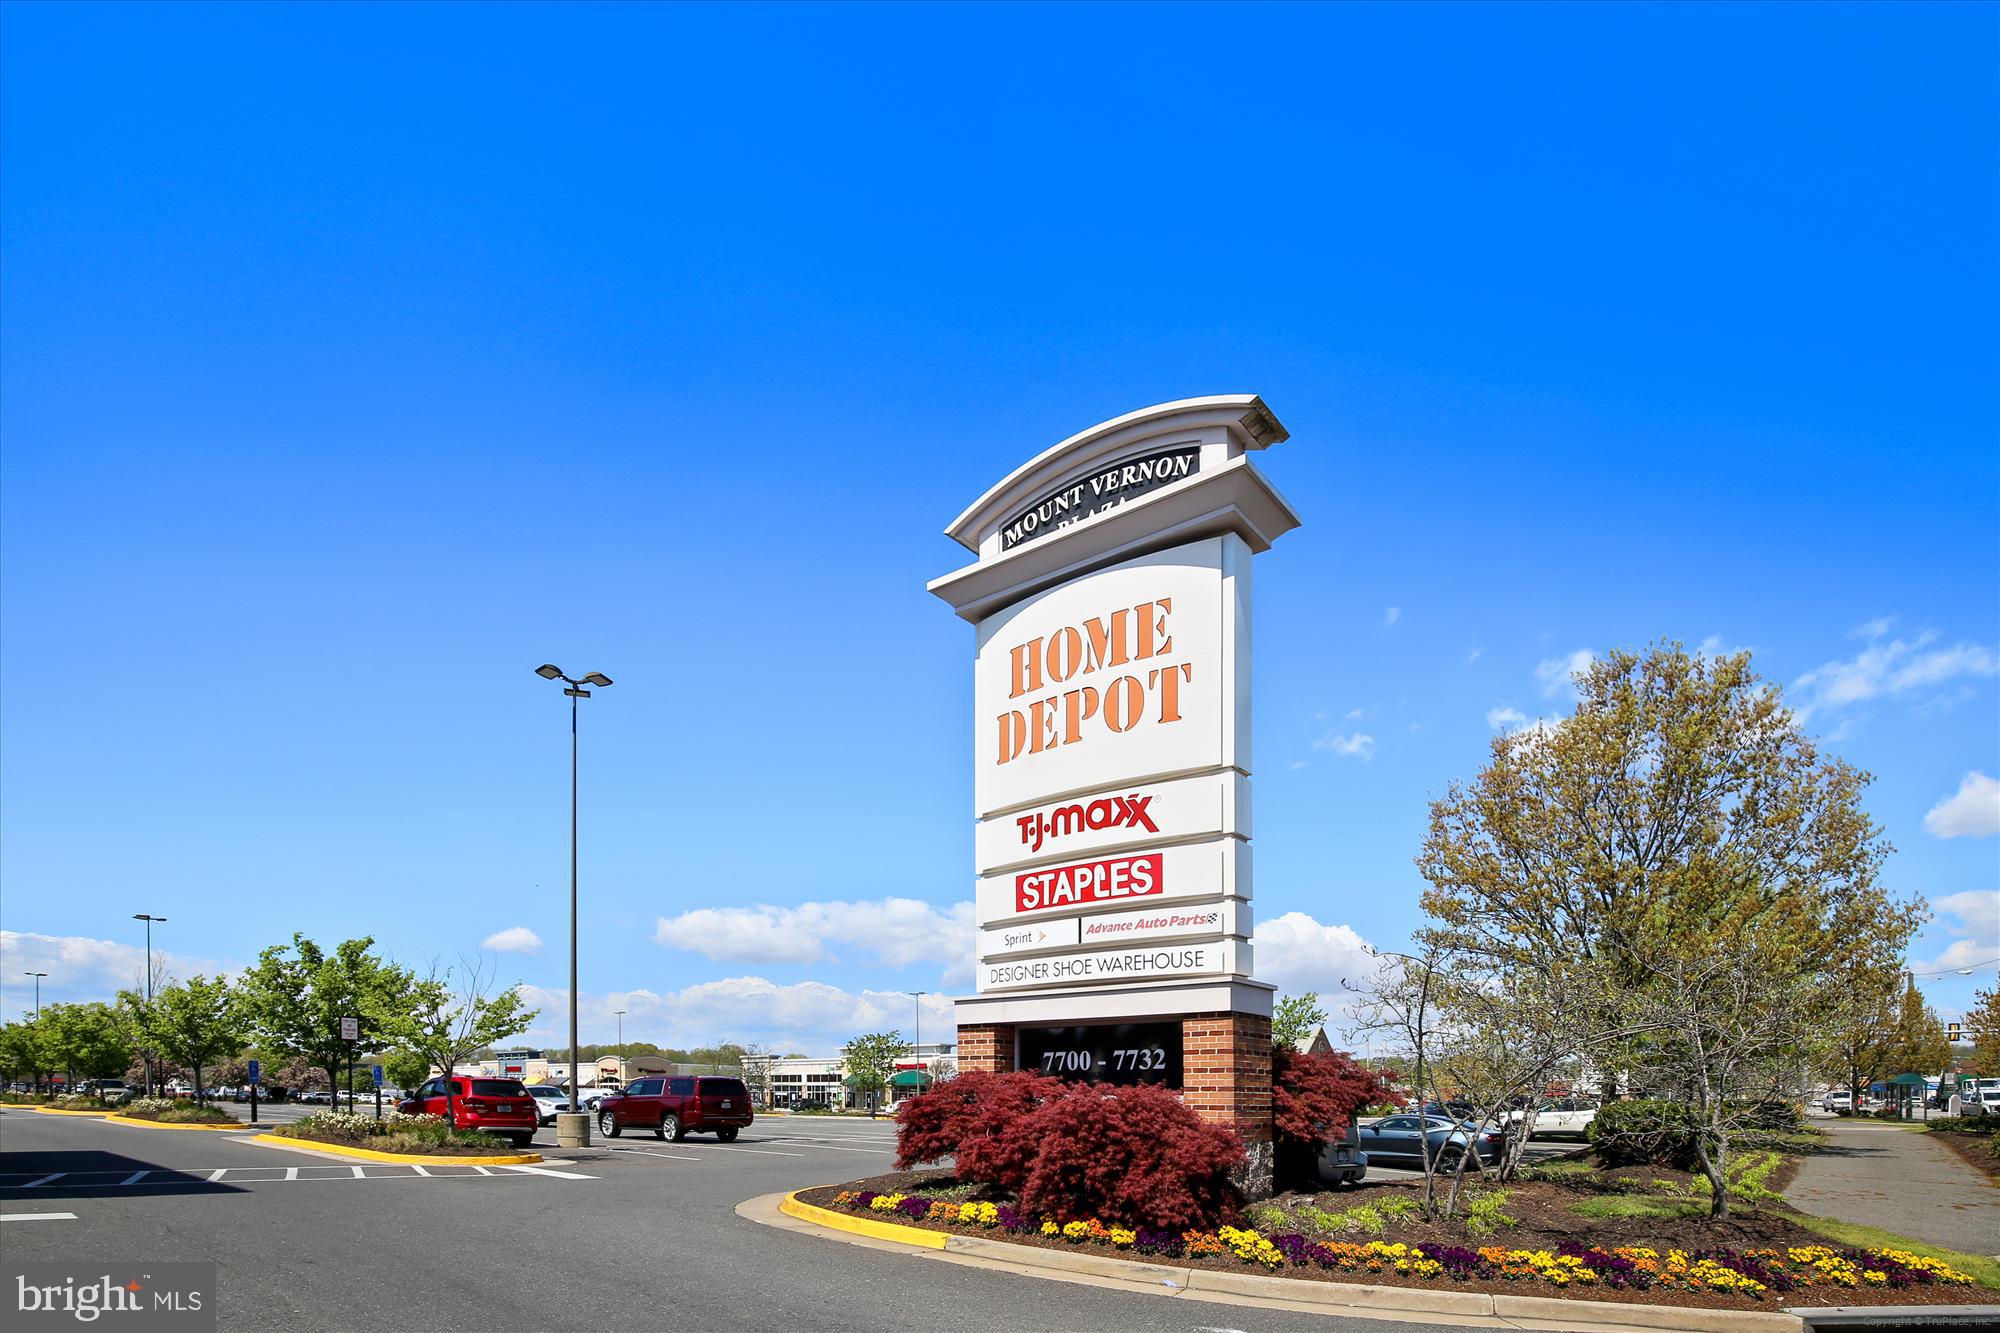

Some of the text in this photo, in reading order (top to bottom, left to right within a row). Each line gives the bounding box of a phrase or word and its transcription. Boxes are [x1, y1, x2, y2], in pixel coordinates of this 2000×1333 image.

[1004, 485, 1085, 547] MOUNT
[1089, 454, 1194, 497] VERNON
[1009, 597, 1172, 699] HOME
[997, 663, 1192, 766] DEPOT
[1022, 859, 1153, 909] STAPLES
[1004, 931, 1033, 949] Sprint
[1086, 914, 1207, 935] Advance Auto Parts
[990, 950, 1204, 984] DESIGNER SHOE WAREHOUSE
[1043, 1050, 1092, 1072] 7700
[1113, 1048, 1166, 1071] 7732
